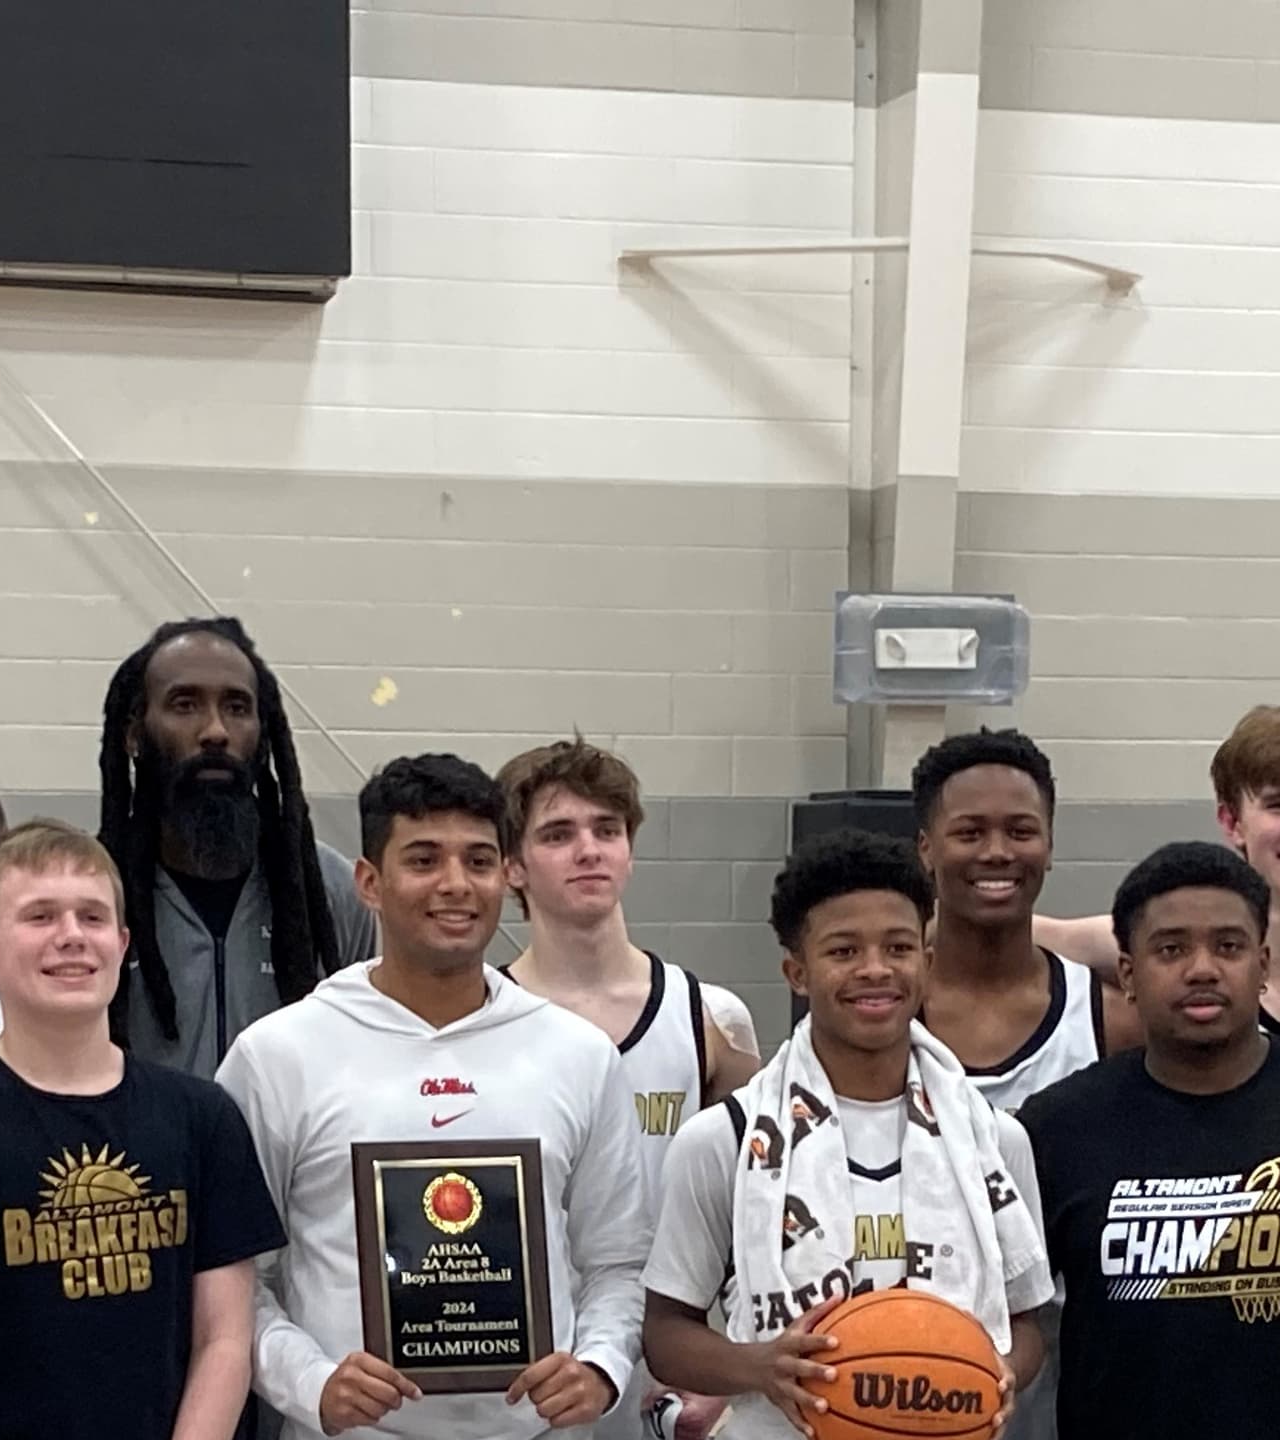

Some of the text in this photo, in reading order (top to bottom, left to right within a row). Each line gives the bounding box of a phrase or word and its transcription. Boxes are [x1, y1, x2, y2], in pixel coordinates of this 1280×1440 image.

[1112, 1174, 1243, 1197] ALTAMONT
[34, 1195, 166, 1222] ALTAMONT
[3, 1189, 188, 1267] BREAKFAST
[427, 1242, 482, 1257] AHSAA
[421, 1256, 490, 1270] 2A Area 8
[62, 1252, 153, 1300] CLUB
[401, 1268, 512, 1287] Boys Basketball
[1168, 1277, 1231, 1294] STANDING
[1234, 1275, 1253, 1290] ON
[442, 1302, 476, 1315] 2024
[401, 1318, 519, 1334] Area Tournament
[402, 1339, 520, 1357] CHAMPIONS
[851, 1372, 984, 1414] Wilson
